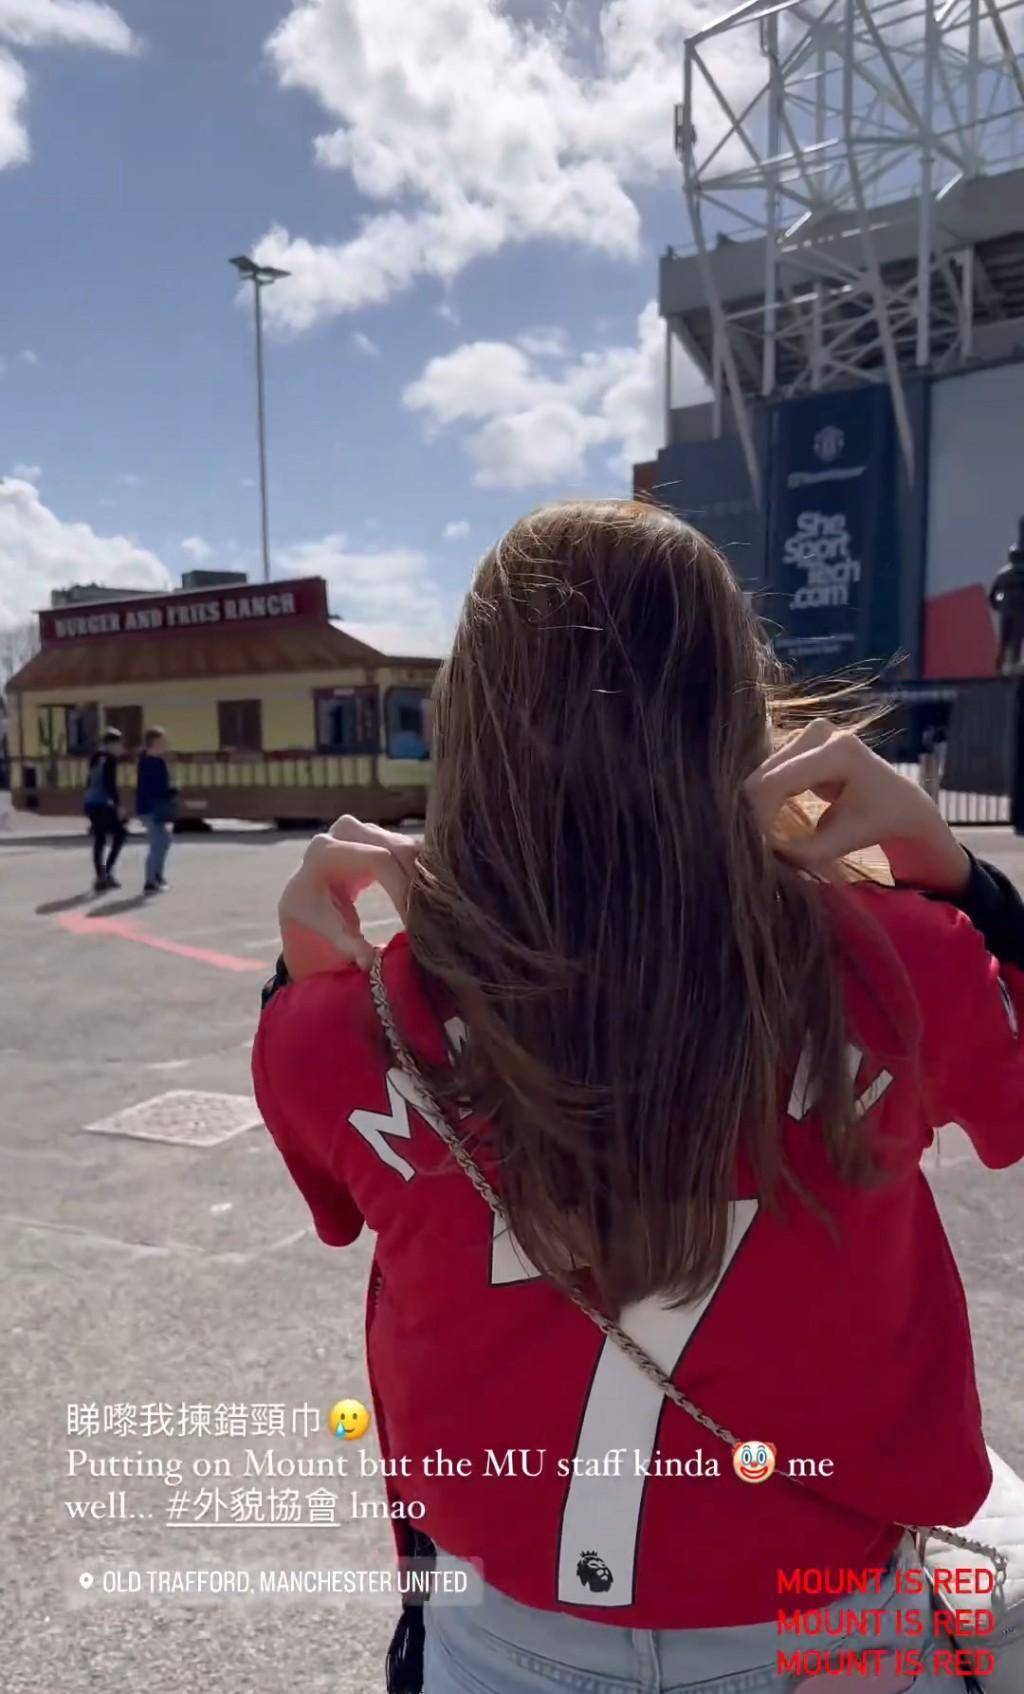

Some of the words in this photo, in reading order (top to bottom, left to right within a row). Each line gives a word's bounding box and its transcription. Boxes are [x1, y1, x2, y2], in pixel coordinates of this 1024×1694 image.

[54, 612, 121, 638] BURGER
[125, 609, 163, 632] AND
[166, 600, 220, 627] FRIES
[223, 592, 295, 621] RANCH
[789, 584, 849, 610] .com
